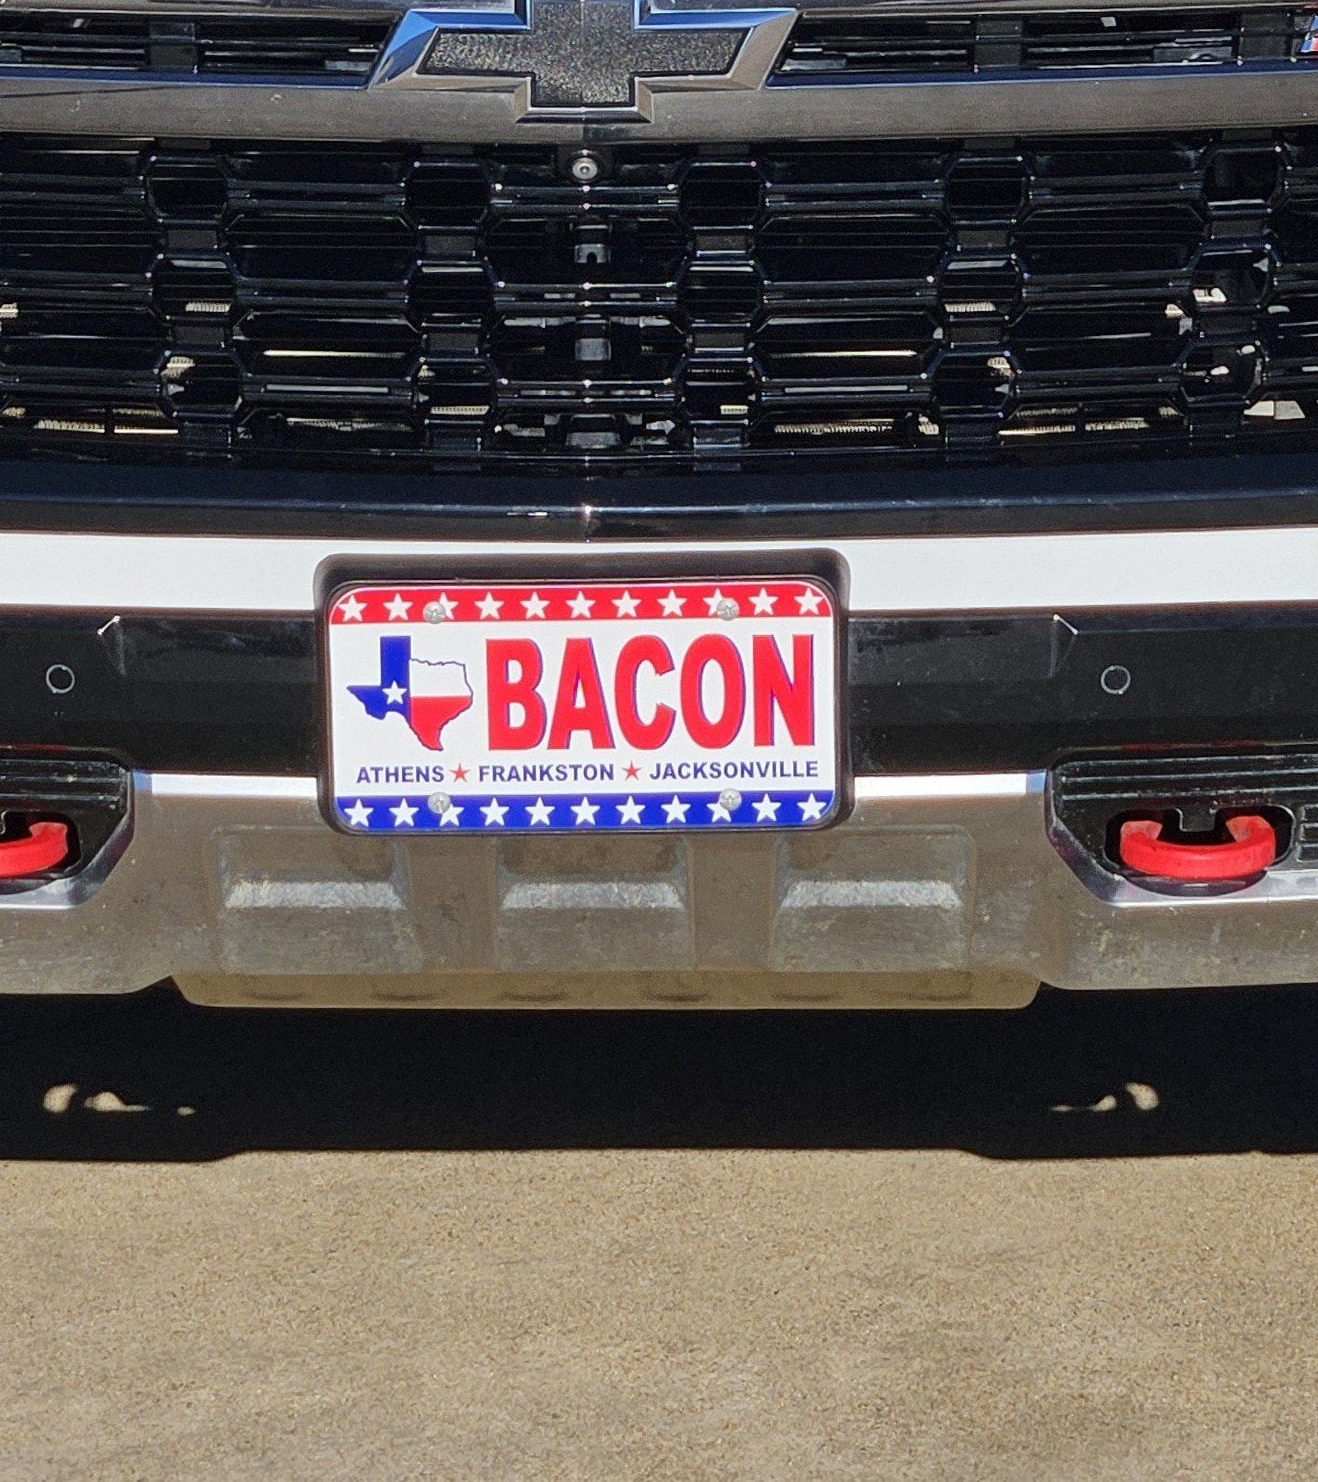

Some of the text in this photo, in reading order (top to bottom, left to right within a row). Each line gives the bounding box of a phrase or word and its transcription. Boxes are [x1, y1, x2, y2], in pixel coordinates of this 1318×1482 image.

[485, 633, 816, 751] BACON
[356, 760, 819, 784] ATHENS FRANKSTON JACKSONVILLE
